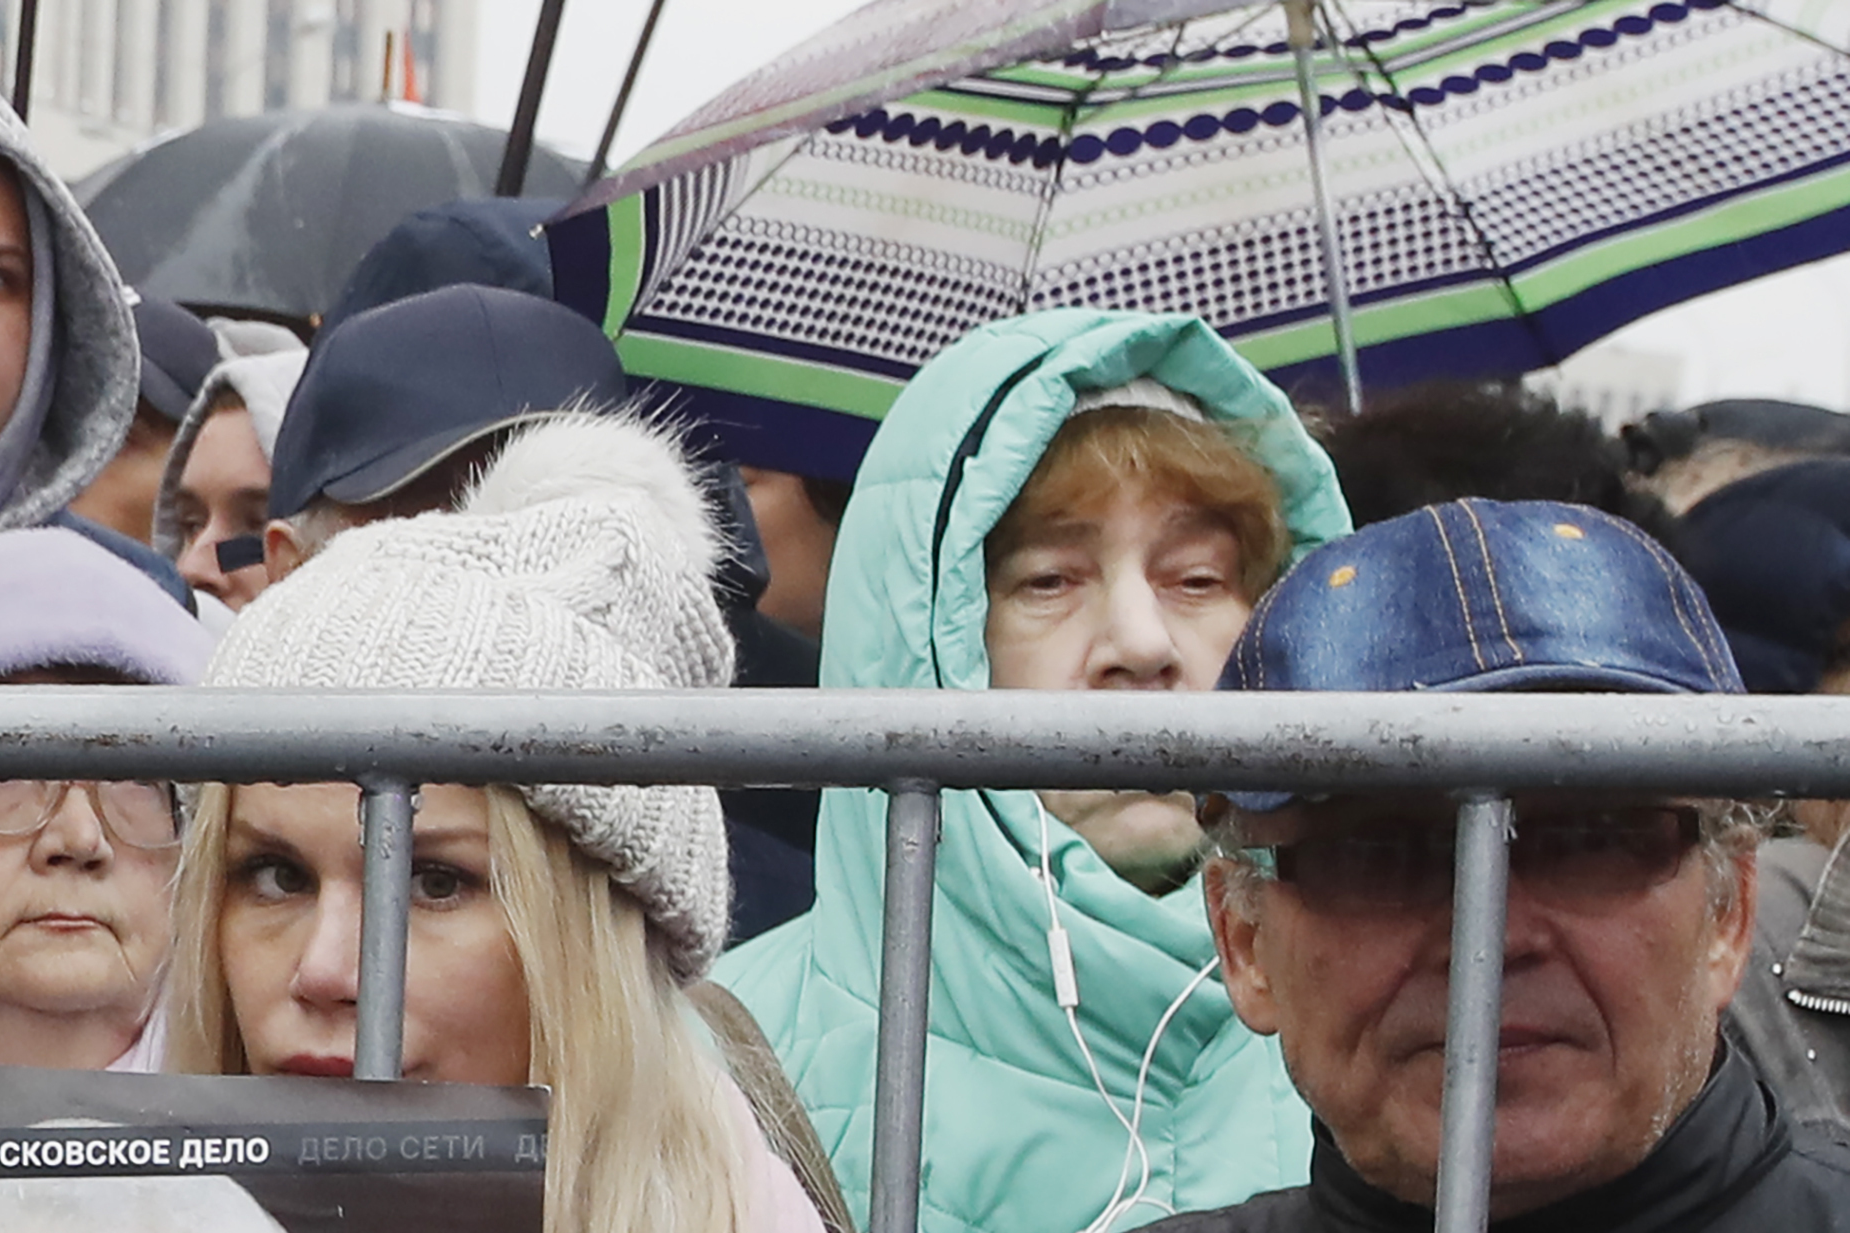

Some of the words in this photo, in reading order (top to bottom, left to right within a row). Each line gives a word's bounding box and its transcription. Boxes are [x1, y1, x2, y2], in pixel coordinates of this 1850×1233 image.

[177, 1137, 270, 1169] ДЕЛО
[298, 1136, 388, 1165] ДЕЛО
[400, 1134, 485, 1160] СЕТИ
